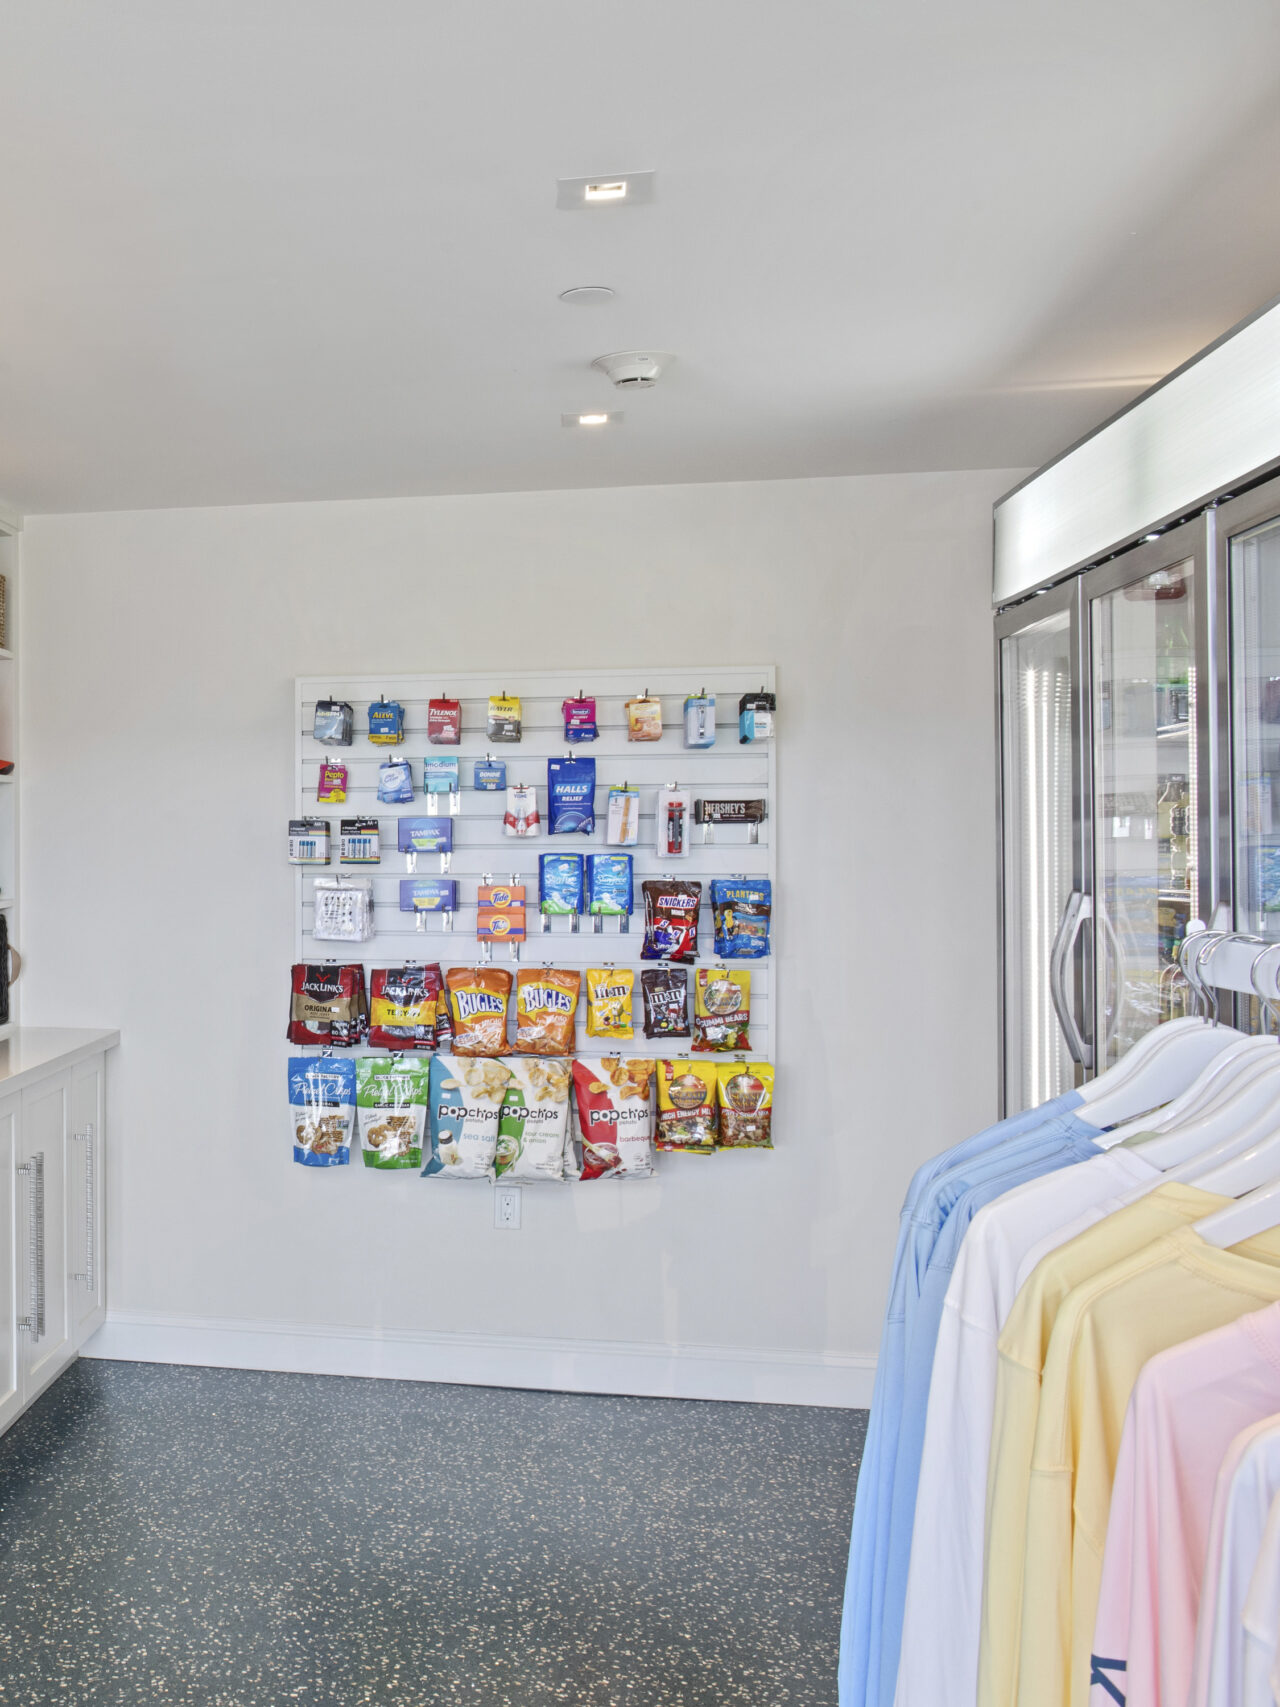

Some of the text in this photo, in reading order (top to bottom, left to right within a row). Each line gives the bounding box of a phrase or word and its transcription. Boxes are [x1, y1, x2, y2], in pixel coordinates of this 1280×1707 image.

[429, 708, 458, 716] TYLENOL
[325, 770, 345, 779] Pepto
[556, 785, 588, 793] HALLS
[705, 803, 746, 814] HERSHEY'S
[409, 829, 441, 837] TAMPAX
[493, 892, 510, 902] Tide
[659, 897, 697, 908] SNICKERS
[300, 982, 343, 993] JACK LINK'S
[381, 986, 402, 996] JACK
[456, 990, 504, 1021] BUGLES
[524, 988, 572, 1012] BUGLES
[304, 1005, 339, 1013] ORIGINA
[725, 1013, 749, 1024] BEARS
[438, 1104, 499, 1121] popchips
[501, 1104, 559, 1121] popchips
[590, 1108, 649, 1126] popchips
[662, 1107, 712, 1120] HIGH ENERGY MIX
[463, 1133, 496, 1142] sea salt
